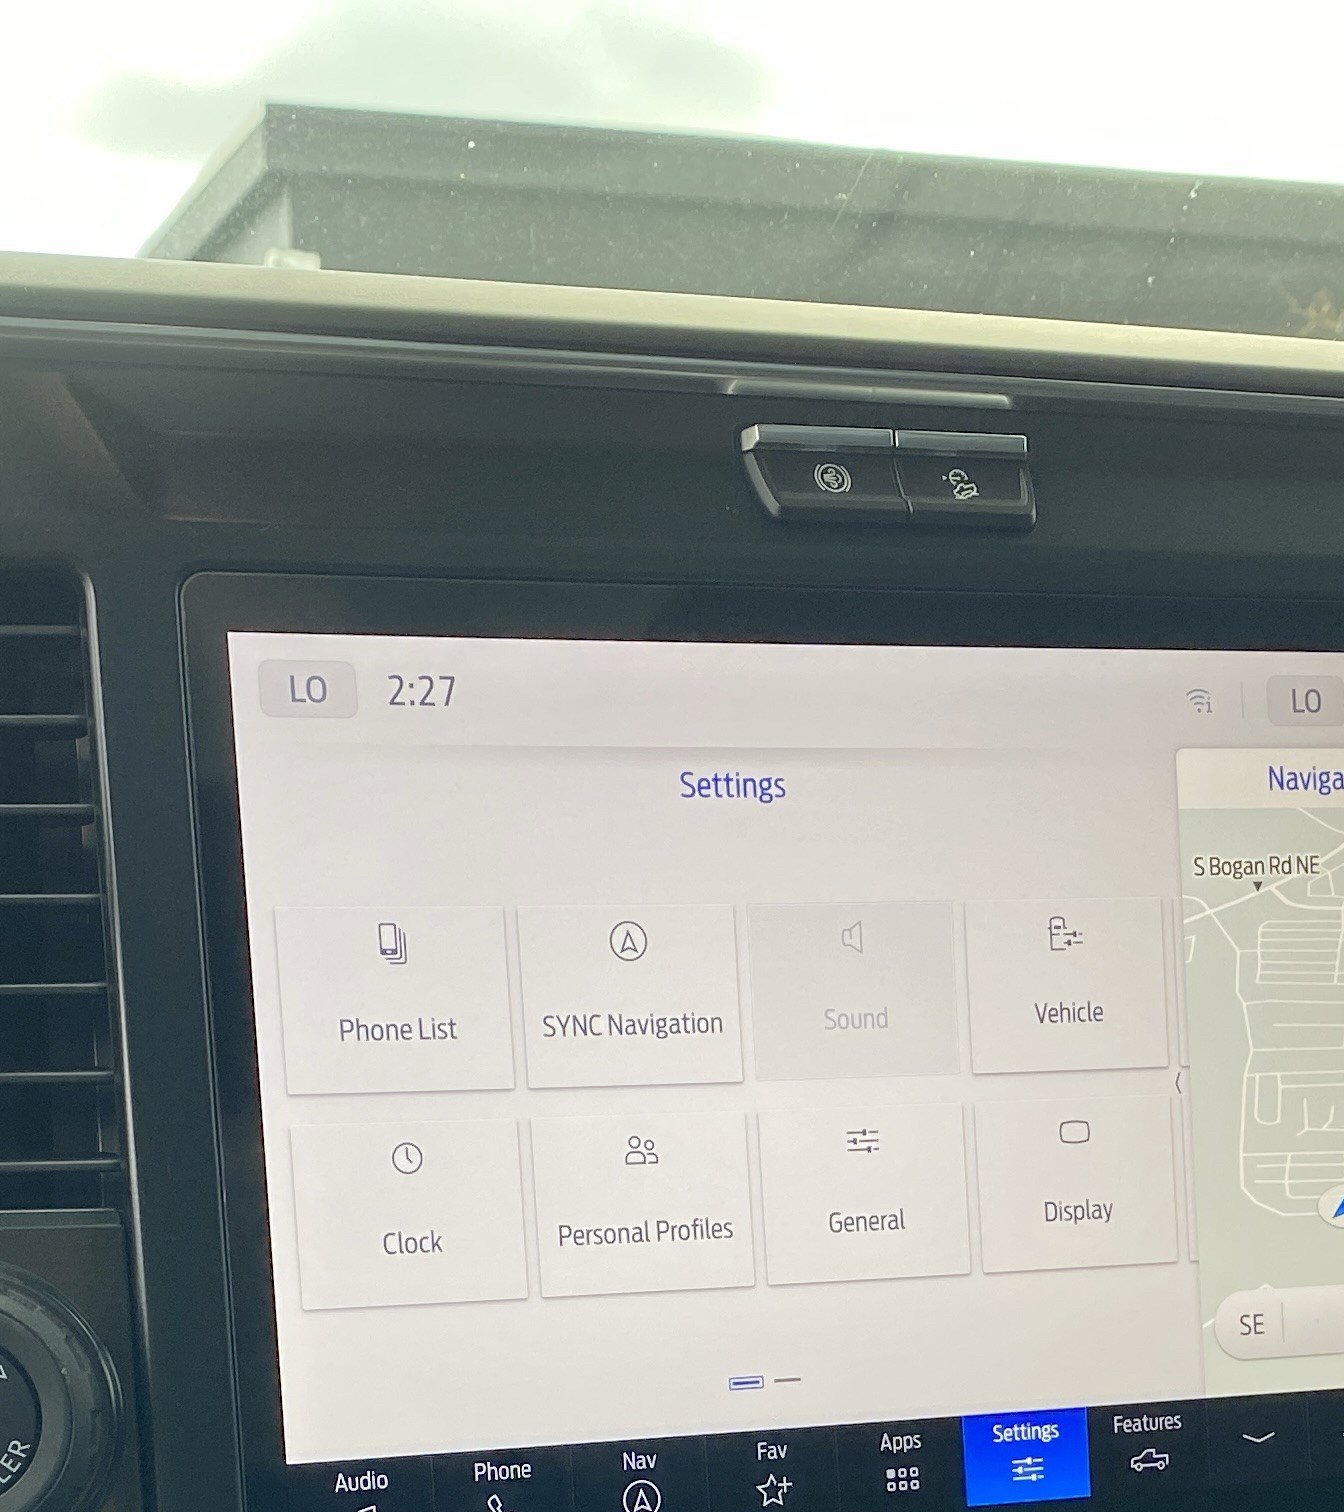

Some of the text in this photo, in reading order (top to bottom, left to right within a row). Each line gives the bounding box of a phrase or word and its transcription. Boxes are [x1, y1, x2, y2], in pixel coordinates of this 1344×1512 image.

[288, 674, 328, 704] LO
[387, 674, 457, 707] 2:27
[1291, 688, 1322, 714] LO
[679, 771, 787, 803] Settings
[1193, 855, 1320, 880] S Bogan Rd NE
[542, 1012, 724, 1039] SYNC Navigation
[823, 1006, 889, 1031] Sound
[1035, 1001, 1104, 1025] Vehicle
[339, 1016, 458, 1042] Phone List
[828, 1207, 906, 1235] General
[1043, 1199, 1113, 1225] Display
[382, 1230, 443, 1256] Clock
[557, 1218, 734, 1247] Personal Profiles
[1239, 1313, 1265, 1337] SE
[992, 1420, 1060, 1447] Settings
[1113, 1411, 1182, 1434] Features
[756, 1441, 788, 1460] Fav
[880, 1431, 922, 1454] Apps
[473, 1459, 532, 1482] Phone
[622, 1451, 657, 1471] Nav
[335, 1470, 389, 1493] Audio
